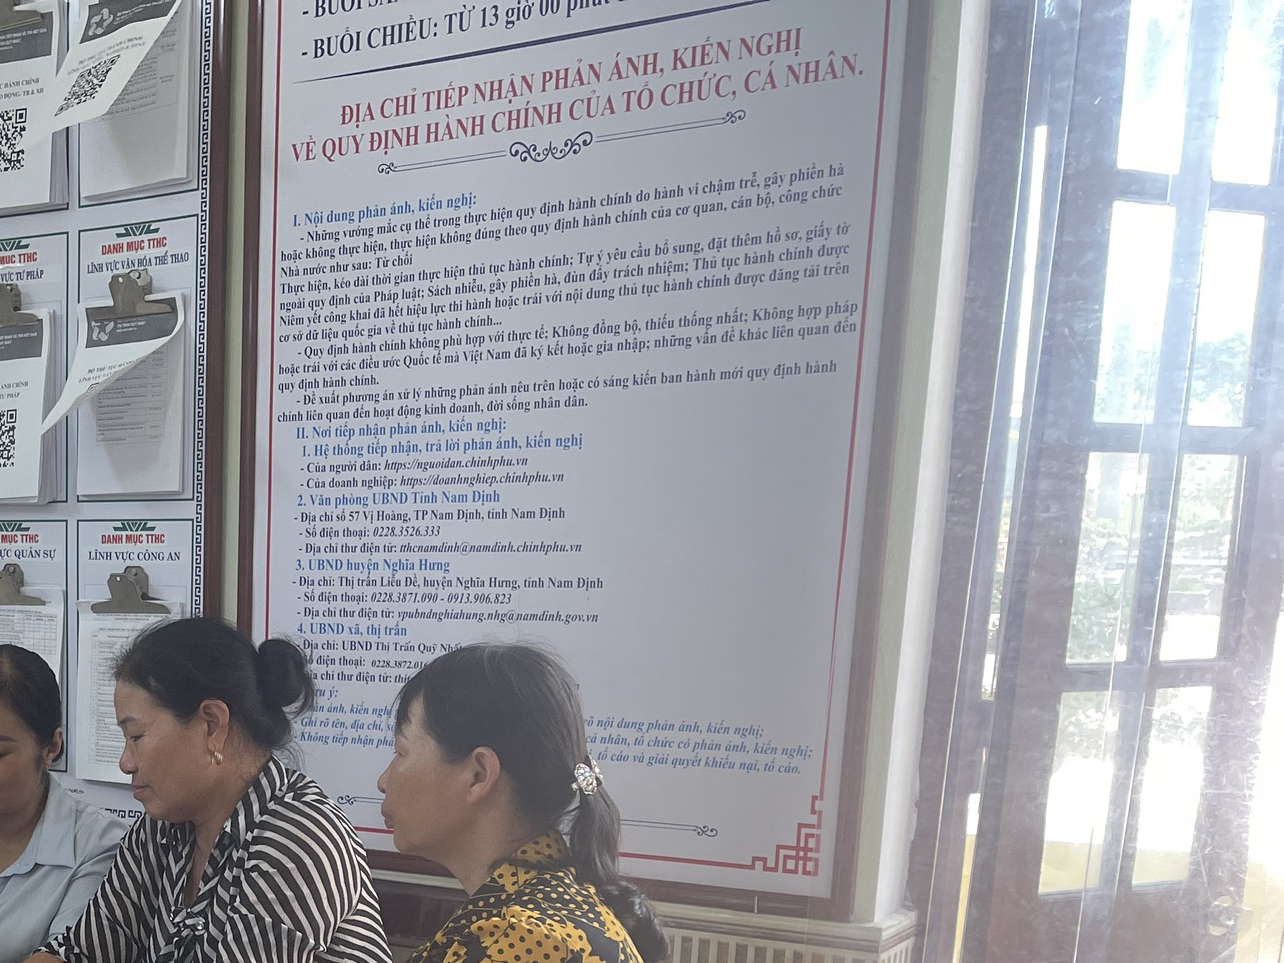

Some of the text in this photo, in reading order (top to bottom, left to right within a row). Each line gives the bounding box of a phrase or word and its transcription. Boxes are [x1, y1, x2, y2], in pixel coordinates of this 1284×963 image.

[312, 1, 534, 59] BUỔI CHIỀU: TỪ 13 giờ
[340, 28, 800, 128] ĐỊA CHỈ TIẾP NHẬN PHẢN ÁNH, KIẾN NGHỊ
[291, 51, 863, 162] VỀ QUY ĐỊNH HÀNH CHÍNH CỦA TỔ CHỨC, CÁ NHÂN.
[293, 192, 476, 228] I. Nội dung phản ánh, kiến nghị:
[101, 236, 167, 255] DANH MỤC TTHC
[280, 251, 412, 278] Nhà nước như sau: Từ chối
[306, 461, 326, 473] Của
[329, 460, 357, 475] người
[359, 459, 381, 471] dân:
[297, 494, 306, 506] 2.
[309, 494, 331, 506] Văn
[334, 493, 368, 510] phòng
[372, 491, 408, 505] UBND
[441, 490, 467, 503] Nam
[472, 489, 499, 506] Định
[0, 533, 18, 545] MỤC
[20, 533, 39, 543] TTHC
[304, 524, 440, 540] Số điện thoại: 0228.3526.333
[13, 546, 41, 559] QUÂN
[42, 548, 56, 561] SỰ
[88, 548, 180, 563] LĨNH VỰC CÔNG AN
[295, 558, 449, 576] 3. UBND huyện Nghĩa Hưng
